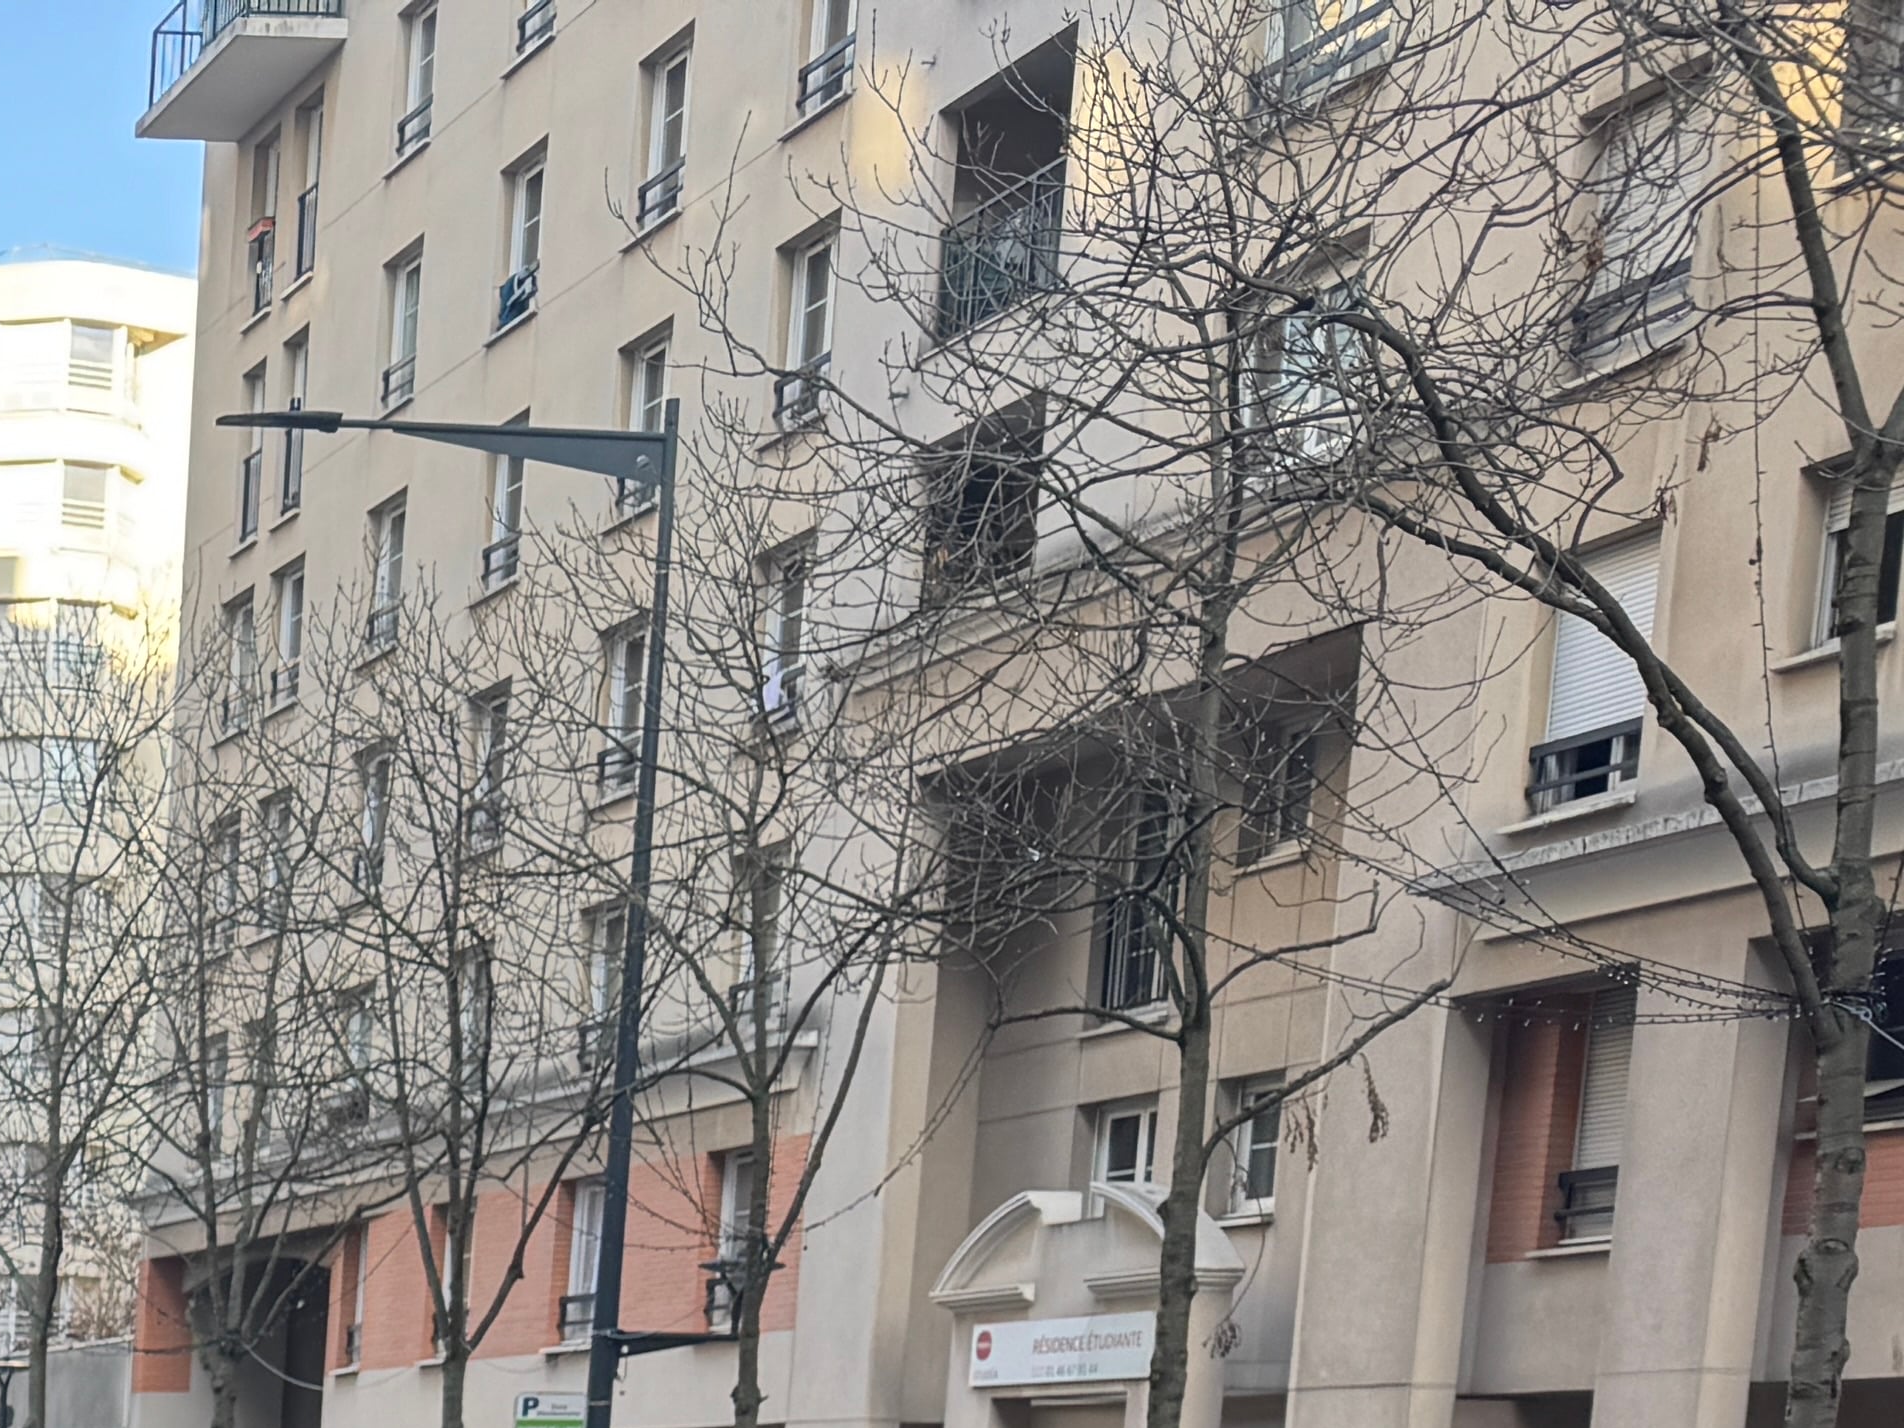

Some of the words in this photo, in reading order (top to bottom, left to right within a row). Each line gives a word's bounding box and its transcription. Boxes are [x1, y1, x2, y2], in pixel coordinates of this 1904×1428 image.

[1032, 1333, 1085, 1355] RÉSIDENCE
[1087, 1329, 1143, 1352] ÉTUDIANTE
[522, 1396, 540, 1417] P
